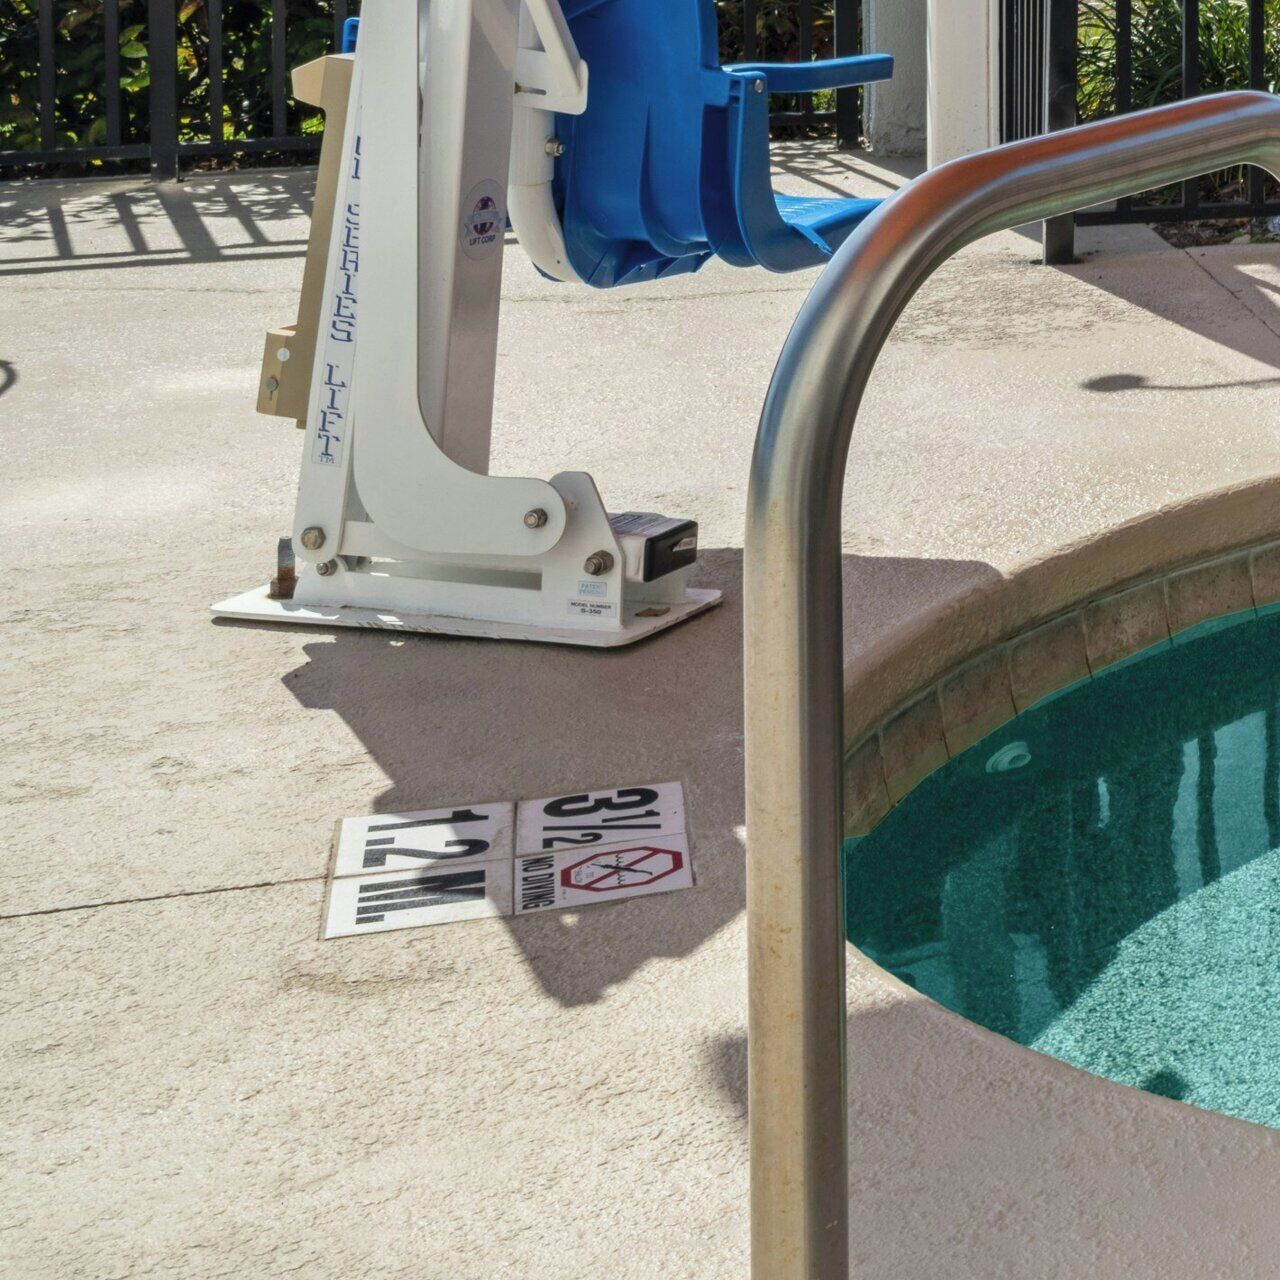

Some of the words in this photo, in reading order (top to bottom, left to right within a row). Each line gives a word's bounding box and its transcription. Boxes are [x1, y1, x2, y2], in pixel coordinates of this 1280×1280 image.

[318, 362, 348, 457] LIFT
[362, 808, 490, 869] 1.2
[521, 855, 555, 873] NO
[521, 872, 556, 911] DIVING
